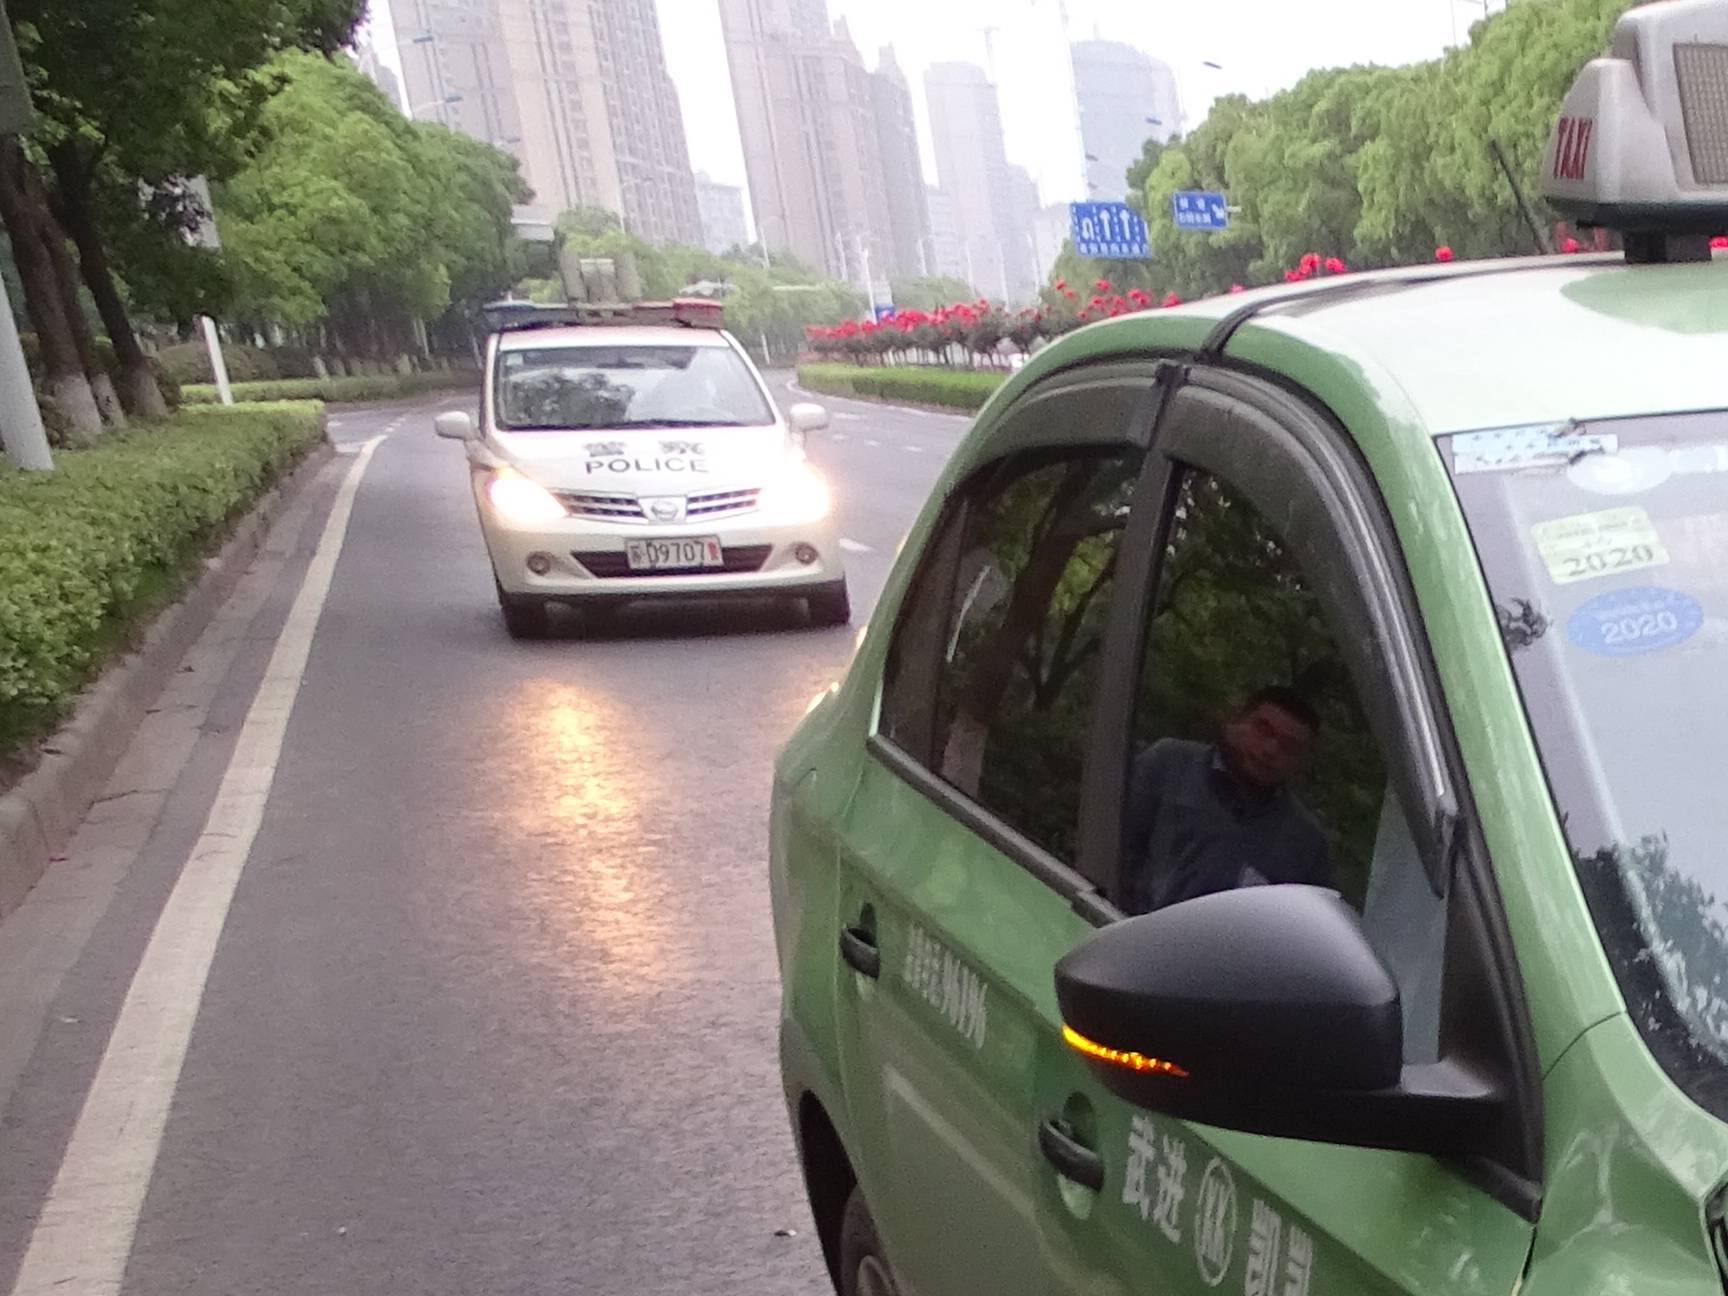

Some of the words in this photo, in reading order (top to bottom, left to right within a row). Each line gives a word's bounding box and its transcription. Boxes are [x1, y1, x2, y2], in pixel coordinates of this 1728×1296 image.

[1553, 116, 1594, 182] TAXI
[585, 457, 709, 474] POLICE
[1562, 543, 1655, 579] 2020
[1600, 611, 1679, 645] 2020
